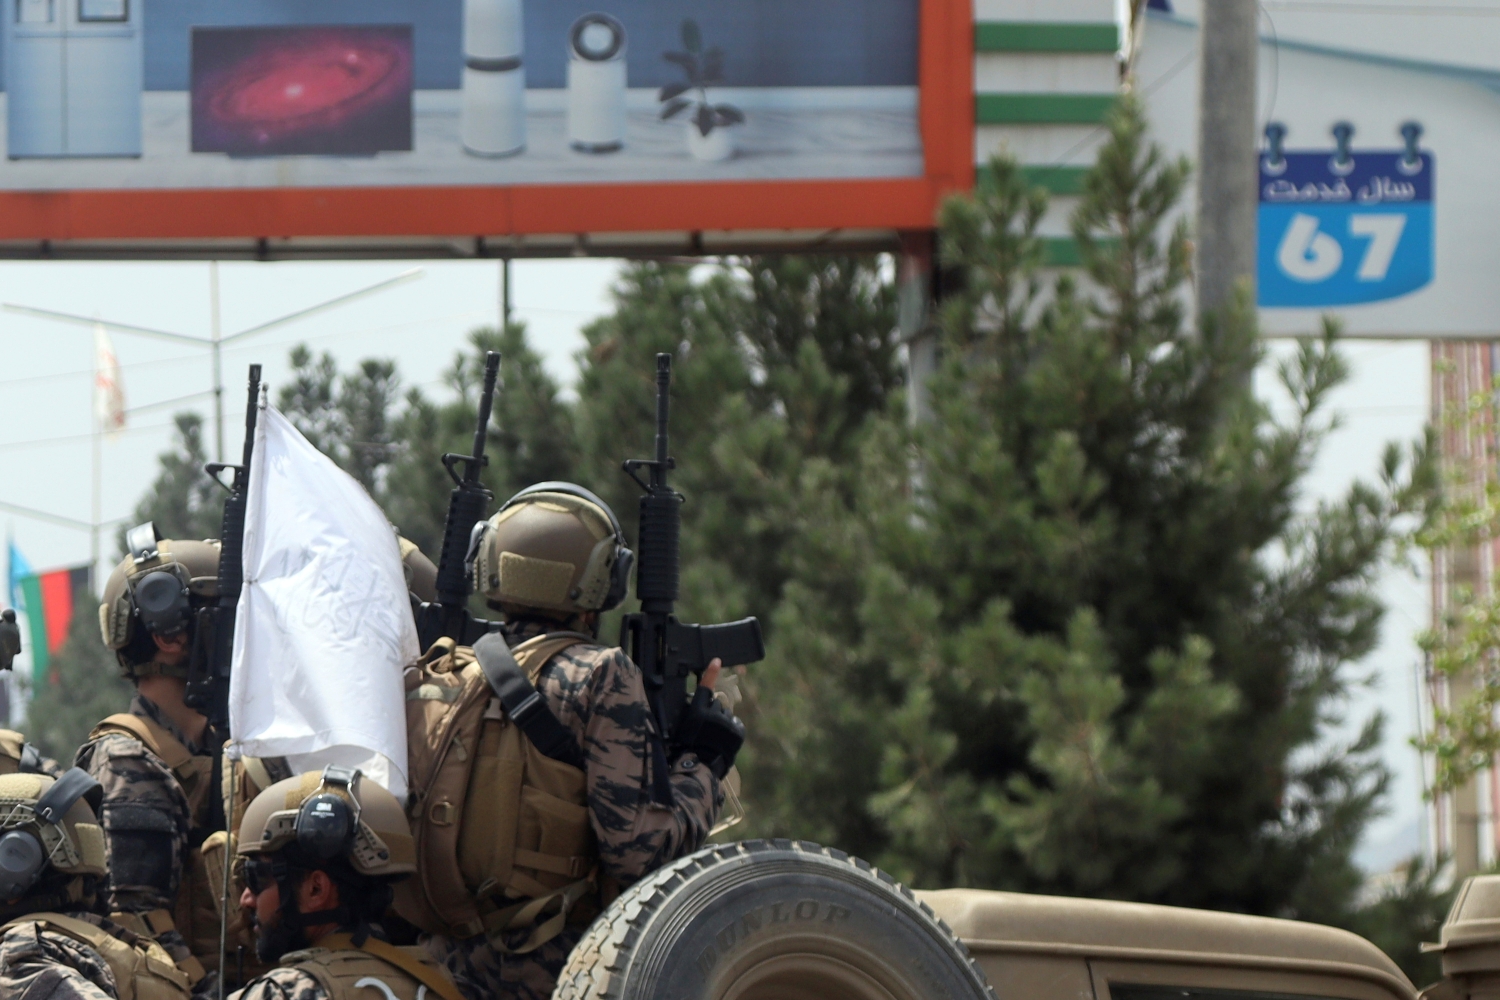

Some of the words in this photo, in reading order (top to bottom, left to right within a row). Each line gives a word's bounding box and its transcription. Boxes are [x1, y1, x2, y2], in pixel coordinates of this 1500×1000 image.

[1262, 176, 1352, 203] خدمت
[1356, 175, 1416, 207] سال
[1276, 212, 1407, 284] 67
[696, 898, 852, 982] DUNLOP
